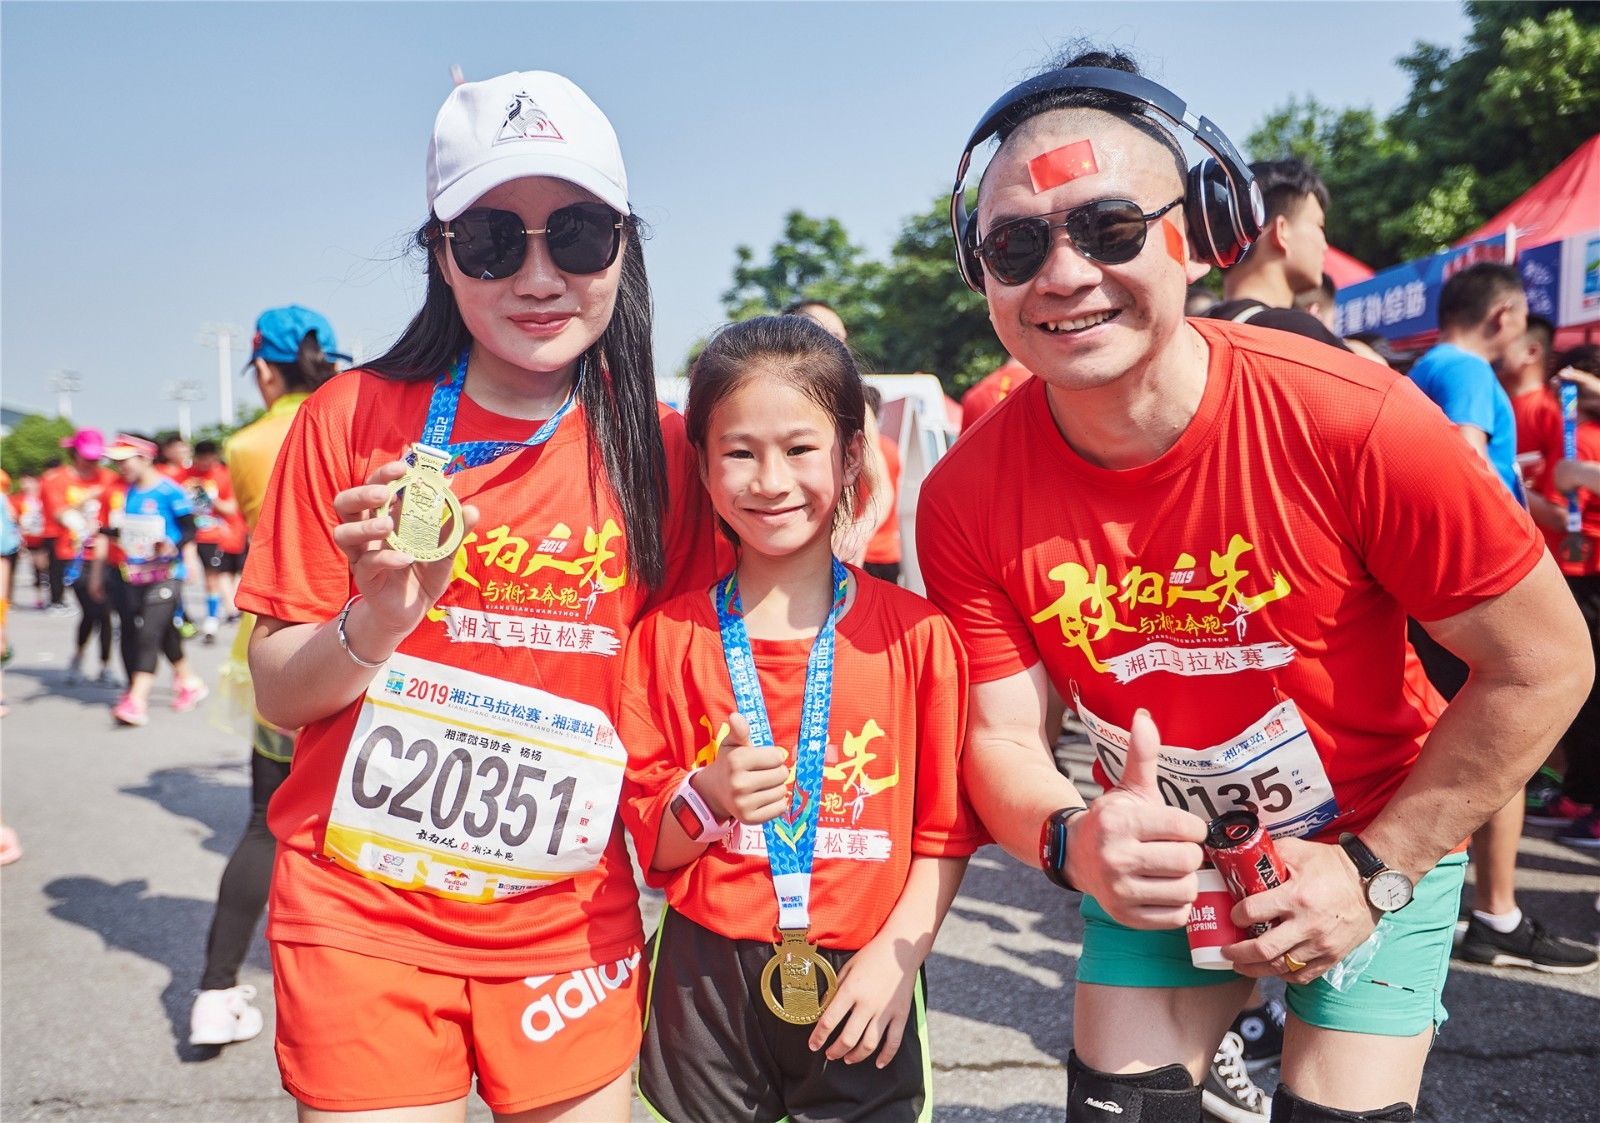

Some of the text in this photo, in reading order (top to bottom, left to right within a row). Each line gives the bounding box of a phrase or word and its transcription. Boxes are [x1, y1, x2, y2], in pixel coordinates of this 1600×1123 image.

[537, 539, 568, 554] 2019
[1169, 570, 1195, 584] 2019
[457, 614, 595, 651] 湘江马拉松赛
[1125, 647, 1264, 677] 湘江马拉松赛
[444, 728, 512, 754] 湘潭微马协会
[351, 725, 578, 856] C20351
[1095, 742, 1293, 819] C0135
[1188, 905, 1217, 923] 山泉
[1192, 922, 1218, 931] SPRING
